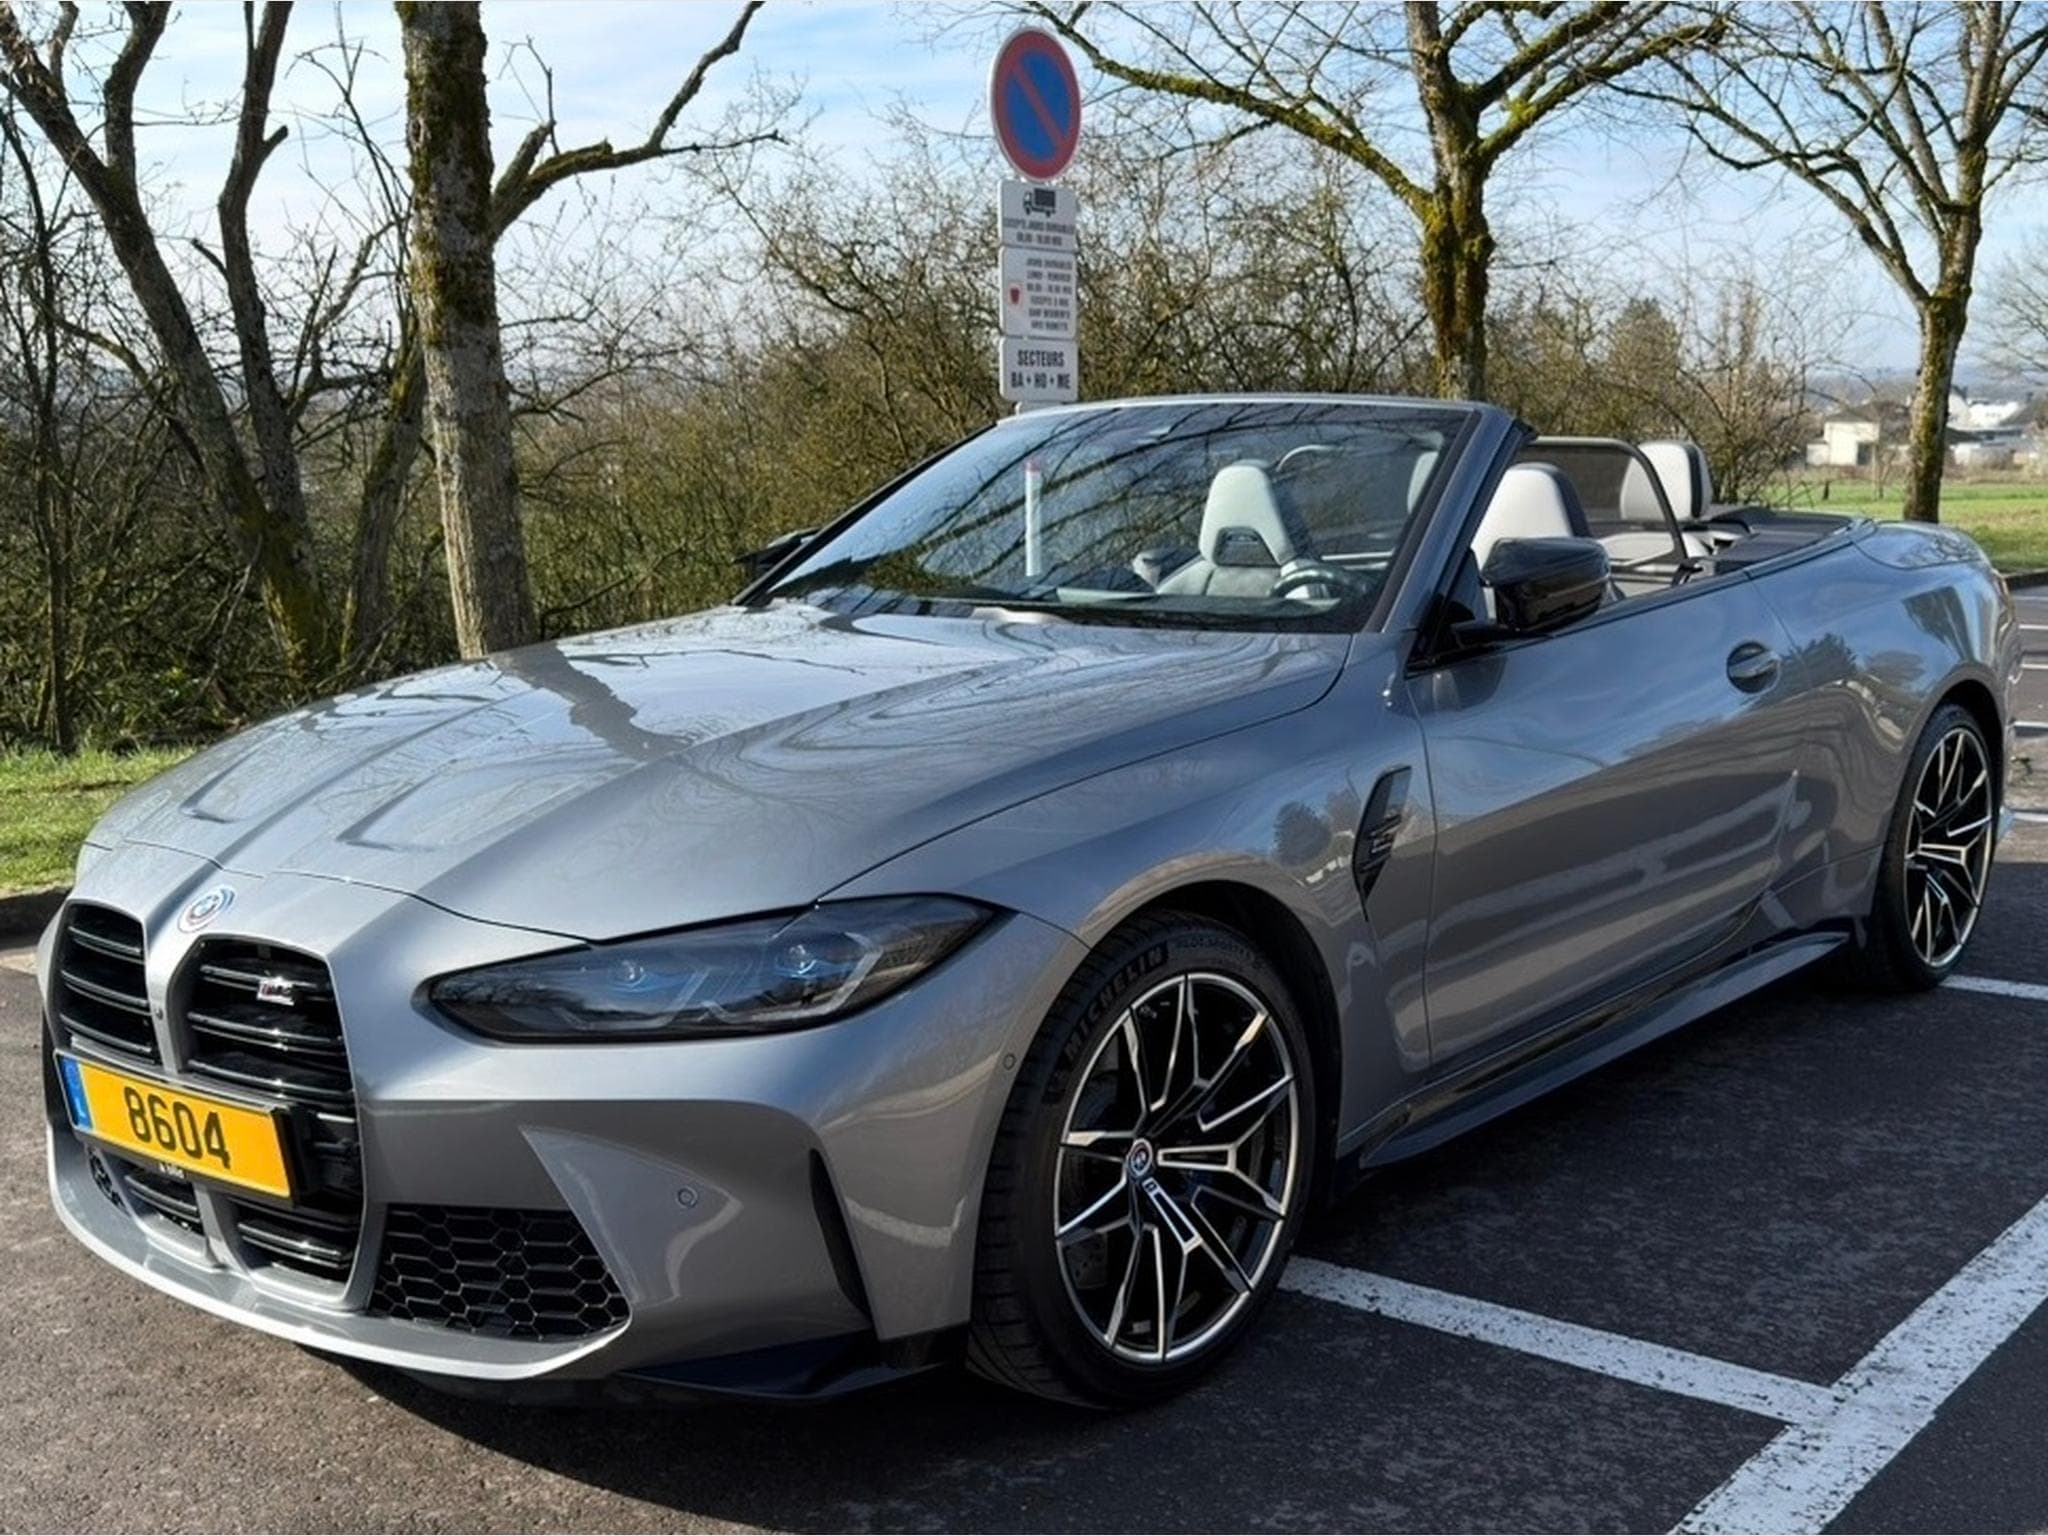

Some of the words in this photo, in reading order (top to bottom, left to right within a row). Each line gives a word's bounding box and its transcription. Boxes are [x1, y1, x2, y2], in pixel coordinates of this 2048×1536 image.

[1018, 350, 1064, 367] SECTEURS
[1064, 945, 1164, 1061] MICHELIN
[124, 1086, 231, 1170] 8604
